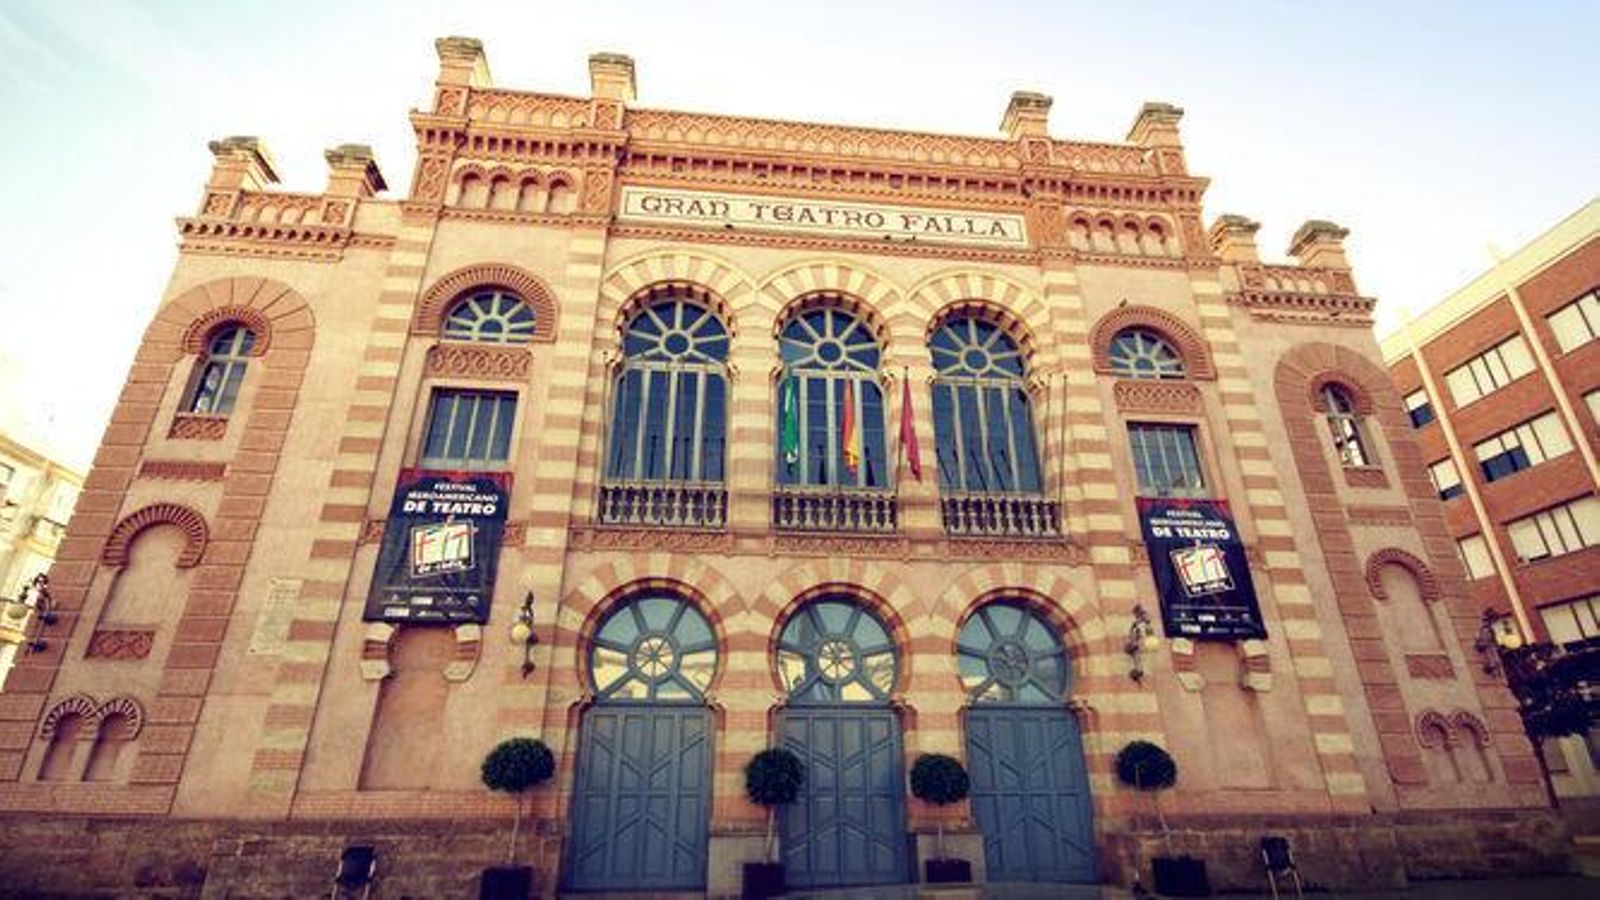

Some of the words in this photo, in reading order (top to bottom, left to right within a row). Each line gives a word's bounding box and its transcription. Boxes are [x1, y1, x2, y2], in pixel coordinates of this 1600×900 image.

[640, 195, 730, 217] GRAN
[748, 202, 885, 228] TEATRO
[899, 214, 1008, 237] FALLA
[403, 500, 427, 512] DE
[432, 502, 497, 515] TEATRO
[1152, 527, 1173, 537] DE
[1175, 527, 1230, 539] TEATRO
